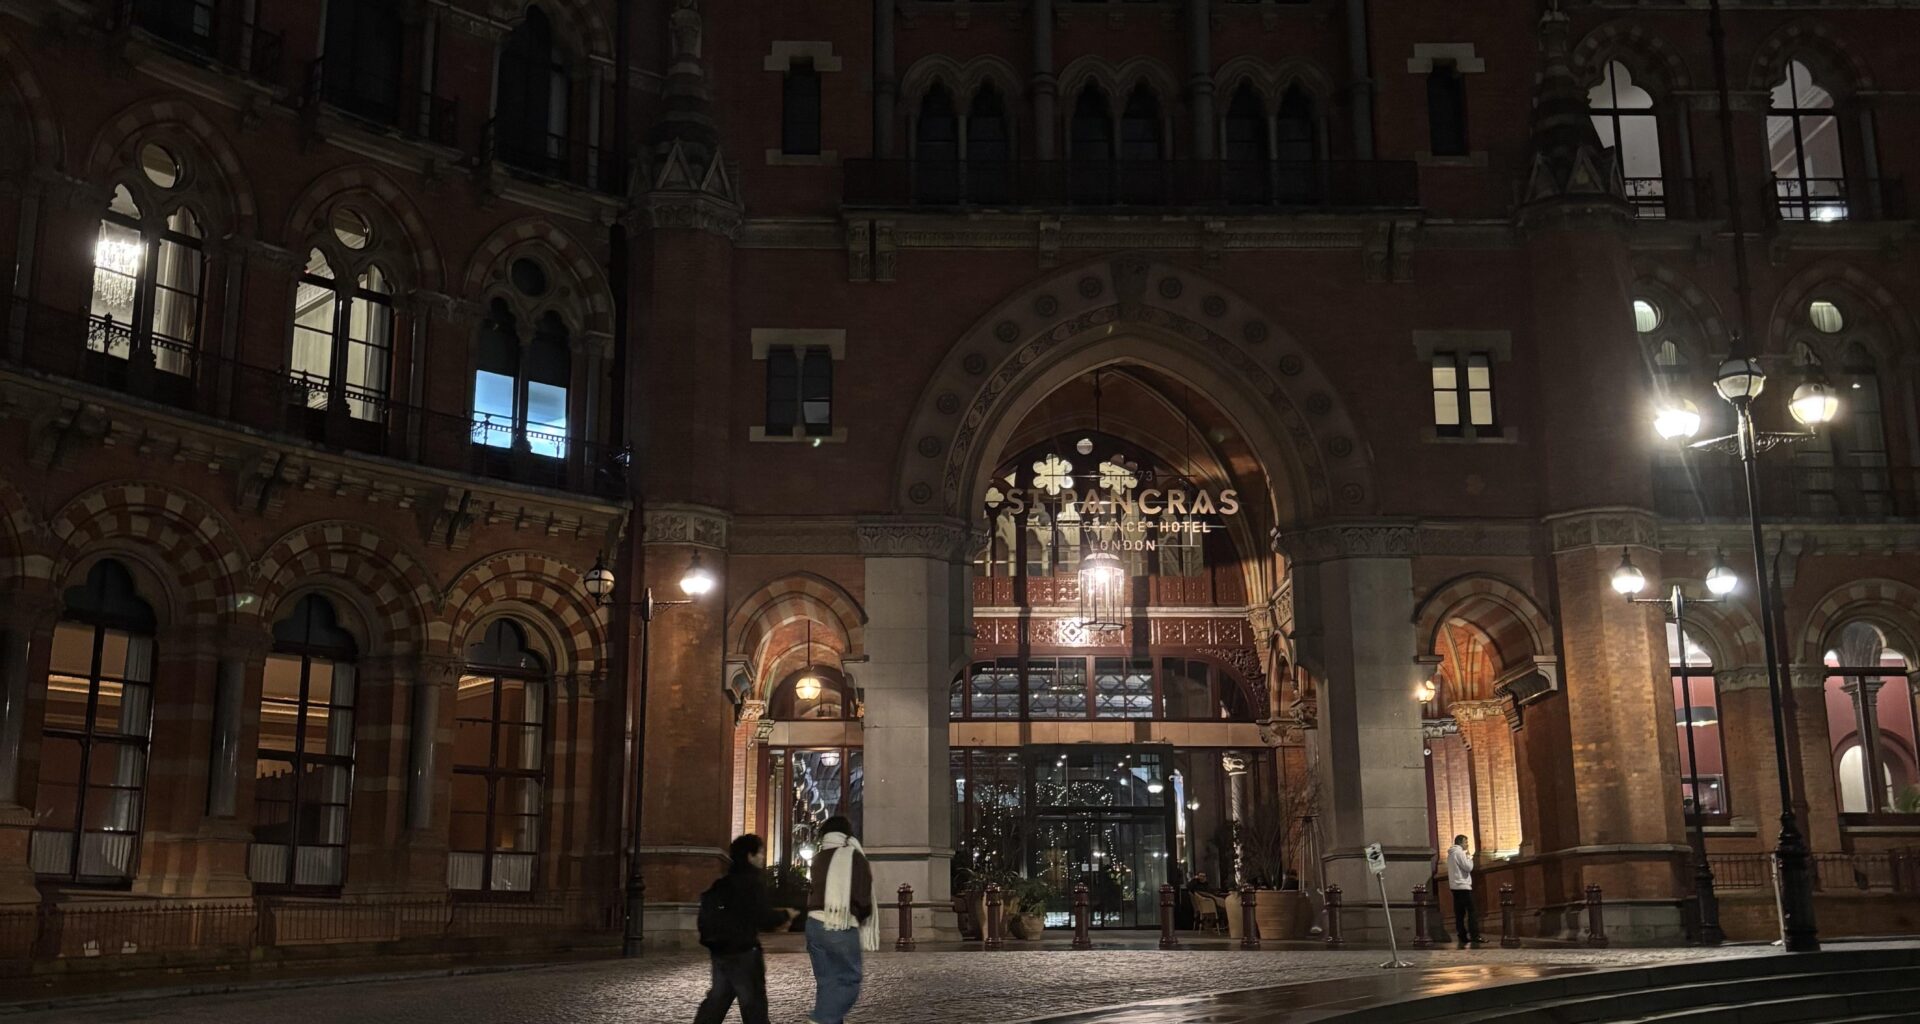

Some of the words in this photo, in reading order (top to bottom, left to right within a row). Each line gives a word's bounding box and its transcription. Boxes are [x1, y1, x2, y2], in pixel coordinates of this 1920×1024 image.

[1061, 488, 1239, 515] PANCRAS
[1159, 521, 1211, 533] HOTEL
[1090, 540, 1156, 552] LONDON
